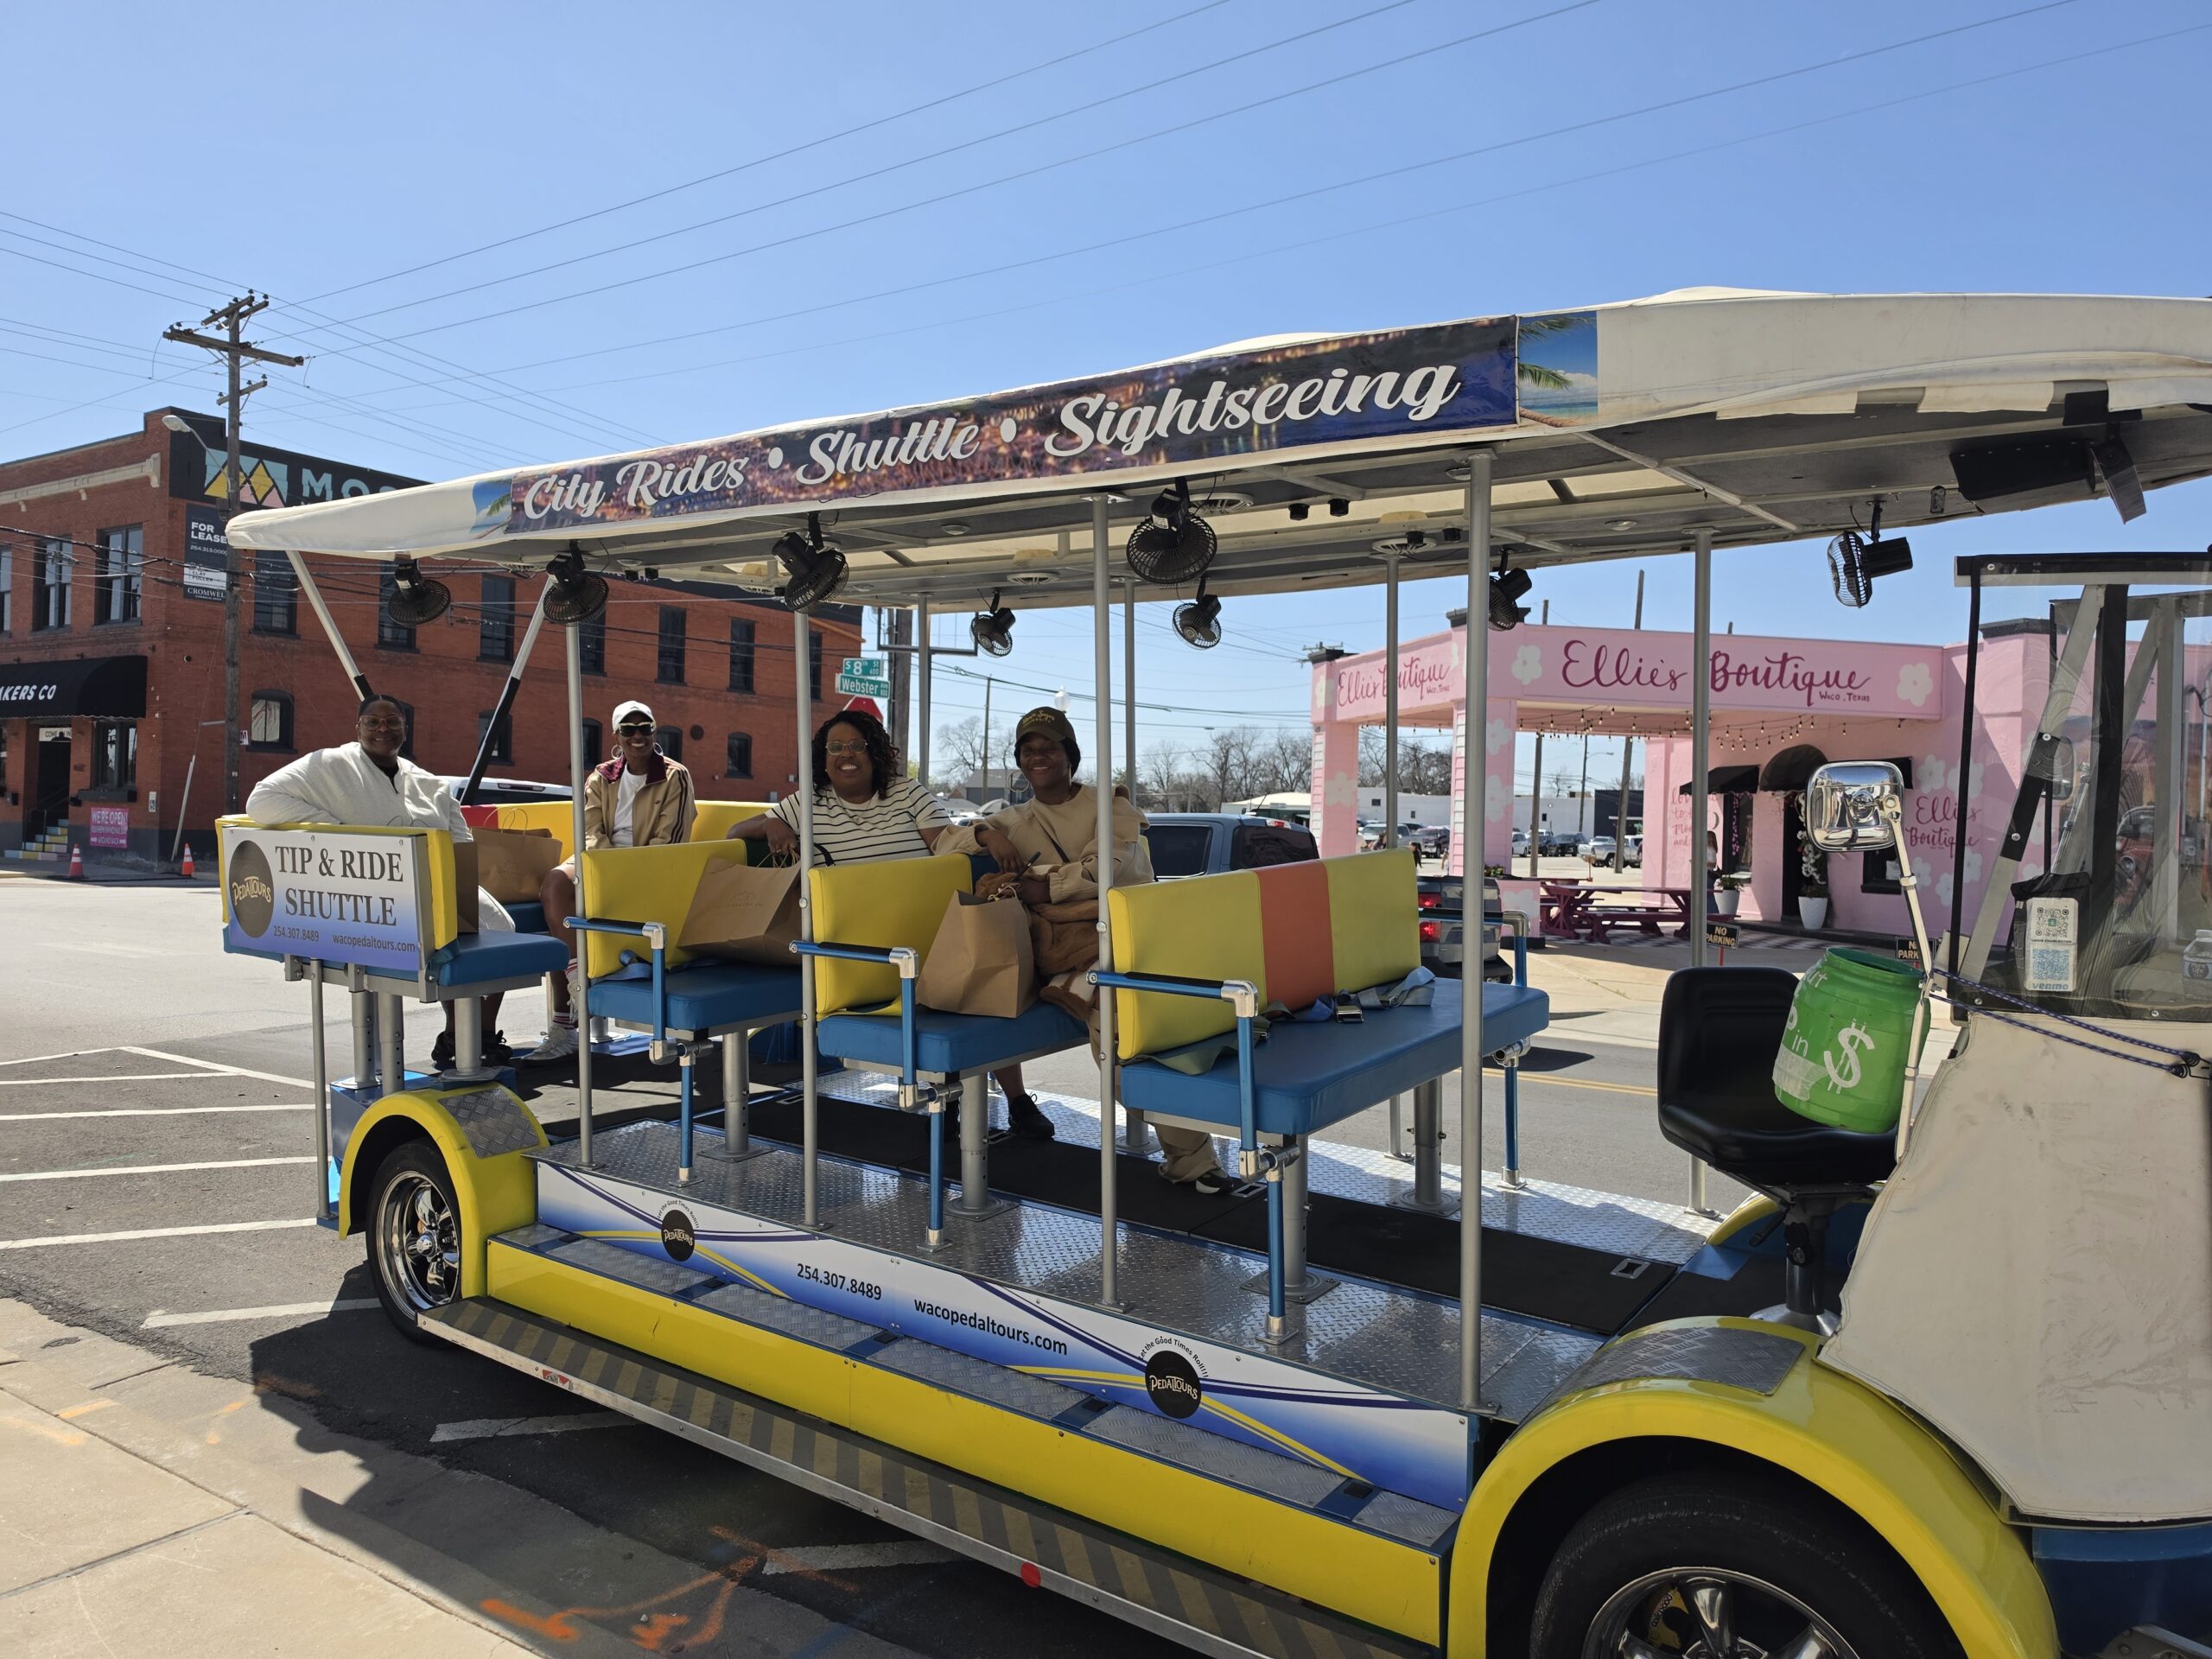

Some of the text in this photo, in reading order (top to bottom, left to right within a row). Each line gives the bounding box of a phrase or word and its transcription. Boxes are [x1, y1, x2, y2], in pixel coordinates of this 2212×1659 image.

[524, 364, 1462, 519] City Rides Shuttle Sightseeing
[191, 522, 214, 533] FOR
[190, 531, 227, 544] LEASE
[188, 588, 226, 599] CROMWEL
[845, 661, 851, 670] S
[1561, 639, 1872, 708] Ellie's Boutique
[38, 684, 57, 701] CO
[842, 677, 879, 696] Webster
[1847, 692, 1871, 702] Texas
[1903, 826, 1980, 859] Boutiqe
[275, 845, 404, 882] TIP & RIDE
[285, 887, 397, 927] SHUTTLE
[273, 925, 416, 953] 254.307.8489 wacopedaltours.com
[1714, 925, 1727, 936] NO
[1706, 933, 1736, 947] PARKING
[1897, 948, 1919, 960] PARK
[678, 1199, 690, 1212] Times
[797, 1262, 882, 1300] 254.307.8489
[914, 1298, 1068, 1356] wacopedaltours.com
[1138, 1348, 1147, 1361] Let
[1144, 1341, 1155, 1351] the
[1154, 1336, 1173, 1345] Good
[1173, 1338, 1193, 1356] Times
